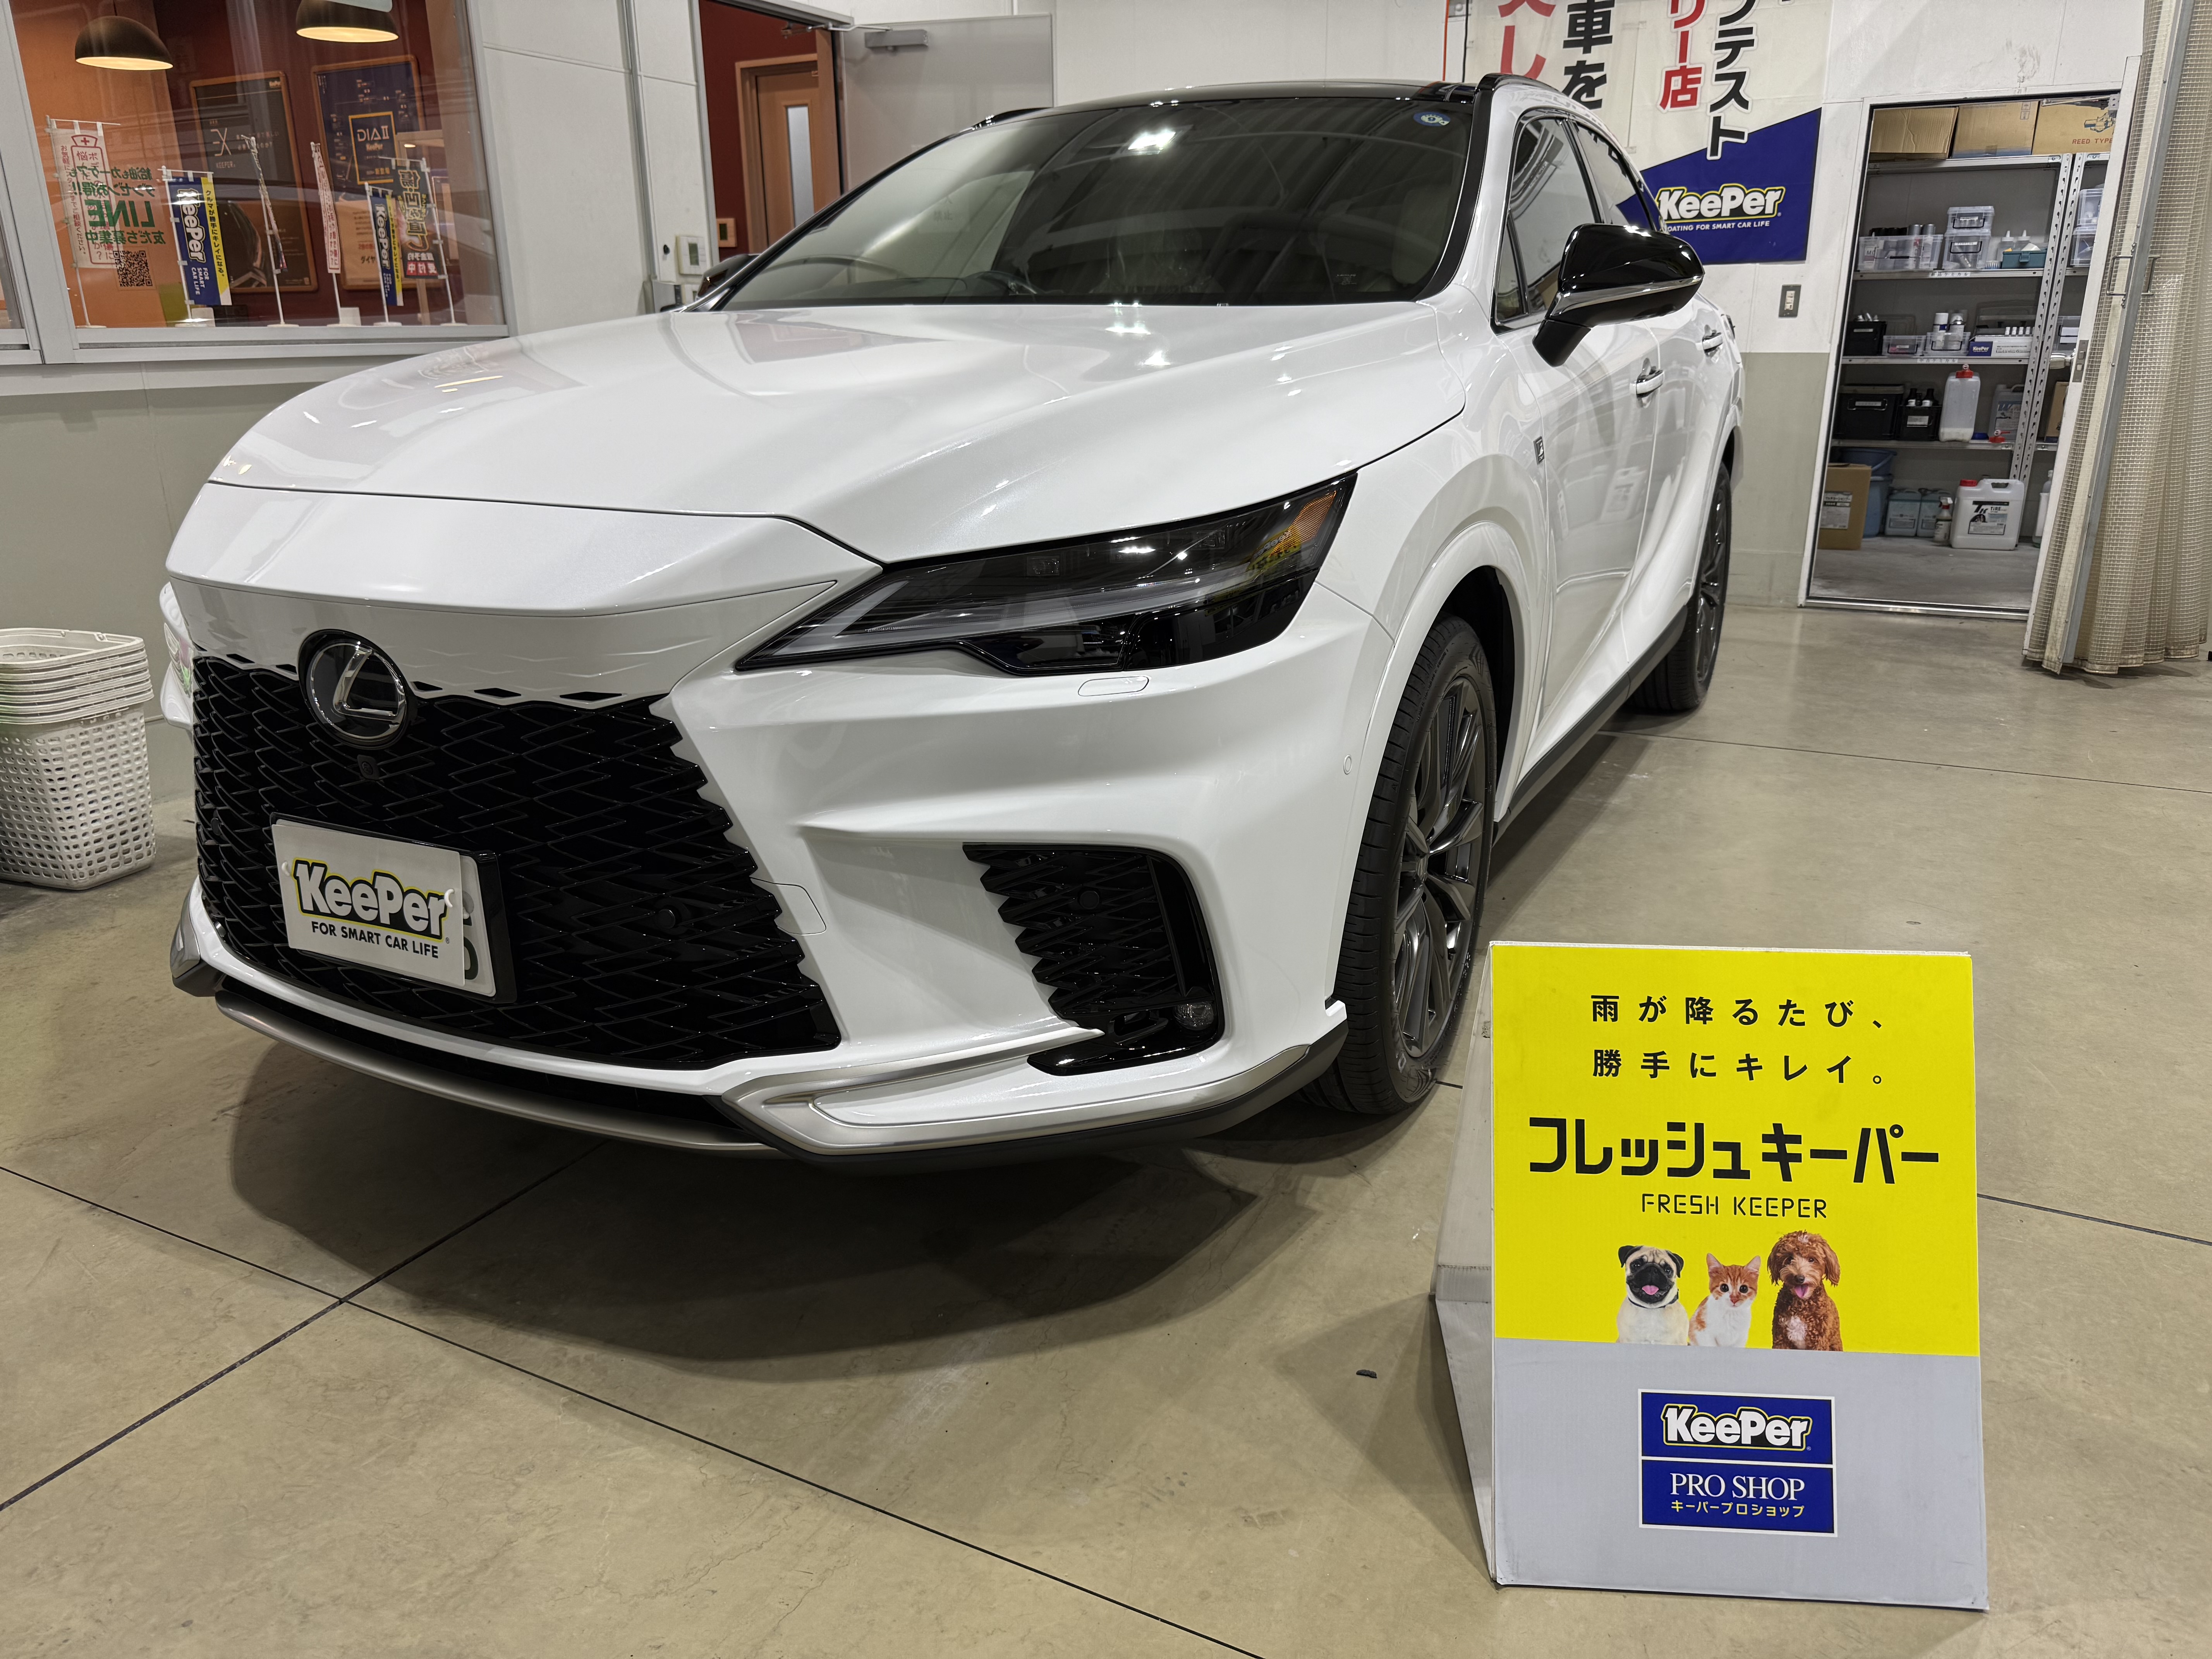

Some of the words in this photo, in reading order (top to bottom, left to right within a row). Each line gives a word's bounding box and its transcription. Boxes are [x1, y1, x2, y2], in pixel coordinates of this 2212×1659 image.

[1563, 0, 1615, 110] 車を
[1659, 187, 1782, 220] KeePer
[375, 204, 390, 269] KeePer
[1666, 224, 1694, 233] OATING
[294, 859, 447, 938] KeePer
[311, 921, 337, 936] FOR
[341, 926, 381, 945] SMART
[385, 935, 409, 951] CAR
[412, 941, 438, 958] LIFE
[1590, 994, 1883, 1029] 雨が降るたび、
[1592, 1049, 1882, 1085] 勝手にキレイ。
[1529, 1117, 1939, 1184] フレッシュキーパー
[1642, 1193, 1719, 1215] FRESH
[1733, 1195, 1827, 1219] KEEPER
[1664, 1407, 1809, 1448] KeePer
[1670, 1473, 1726, 1498] PRO
[1732, 1476, 1805, 1501] SHOP
[1671, 1499, 1805, 1518] キーパープロショップ
